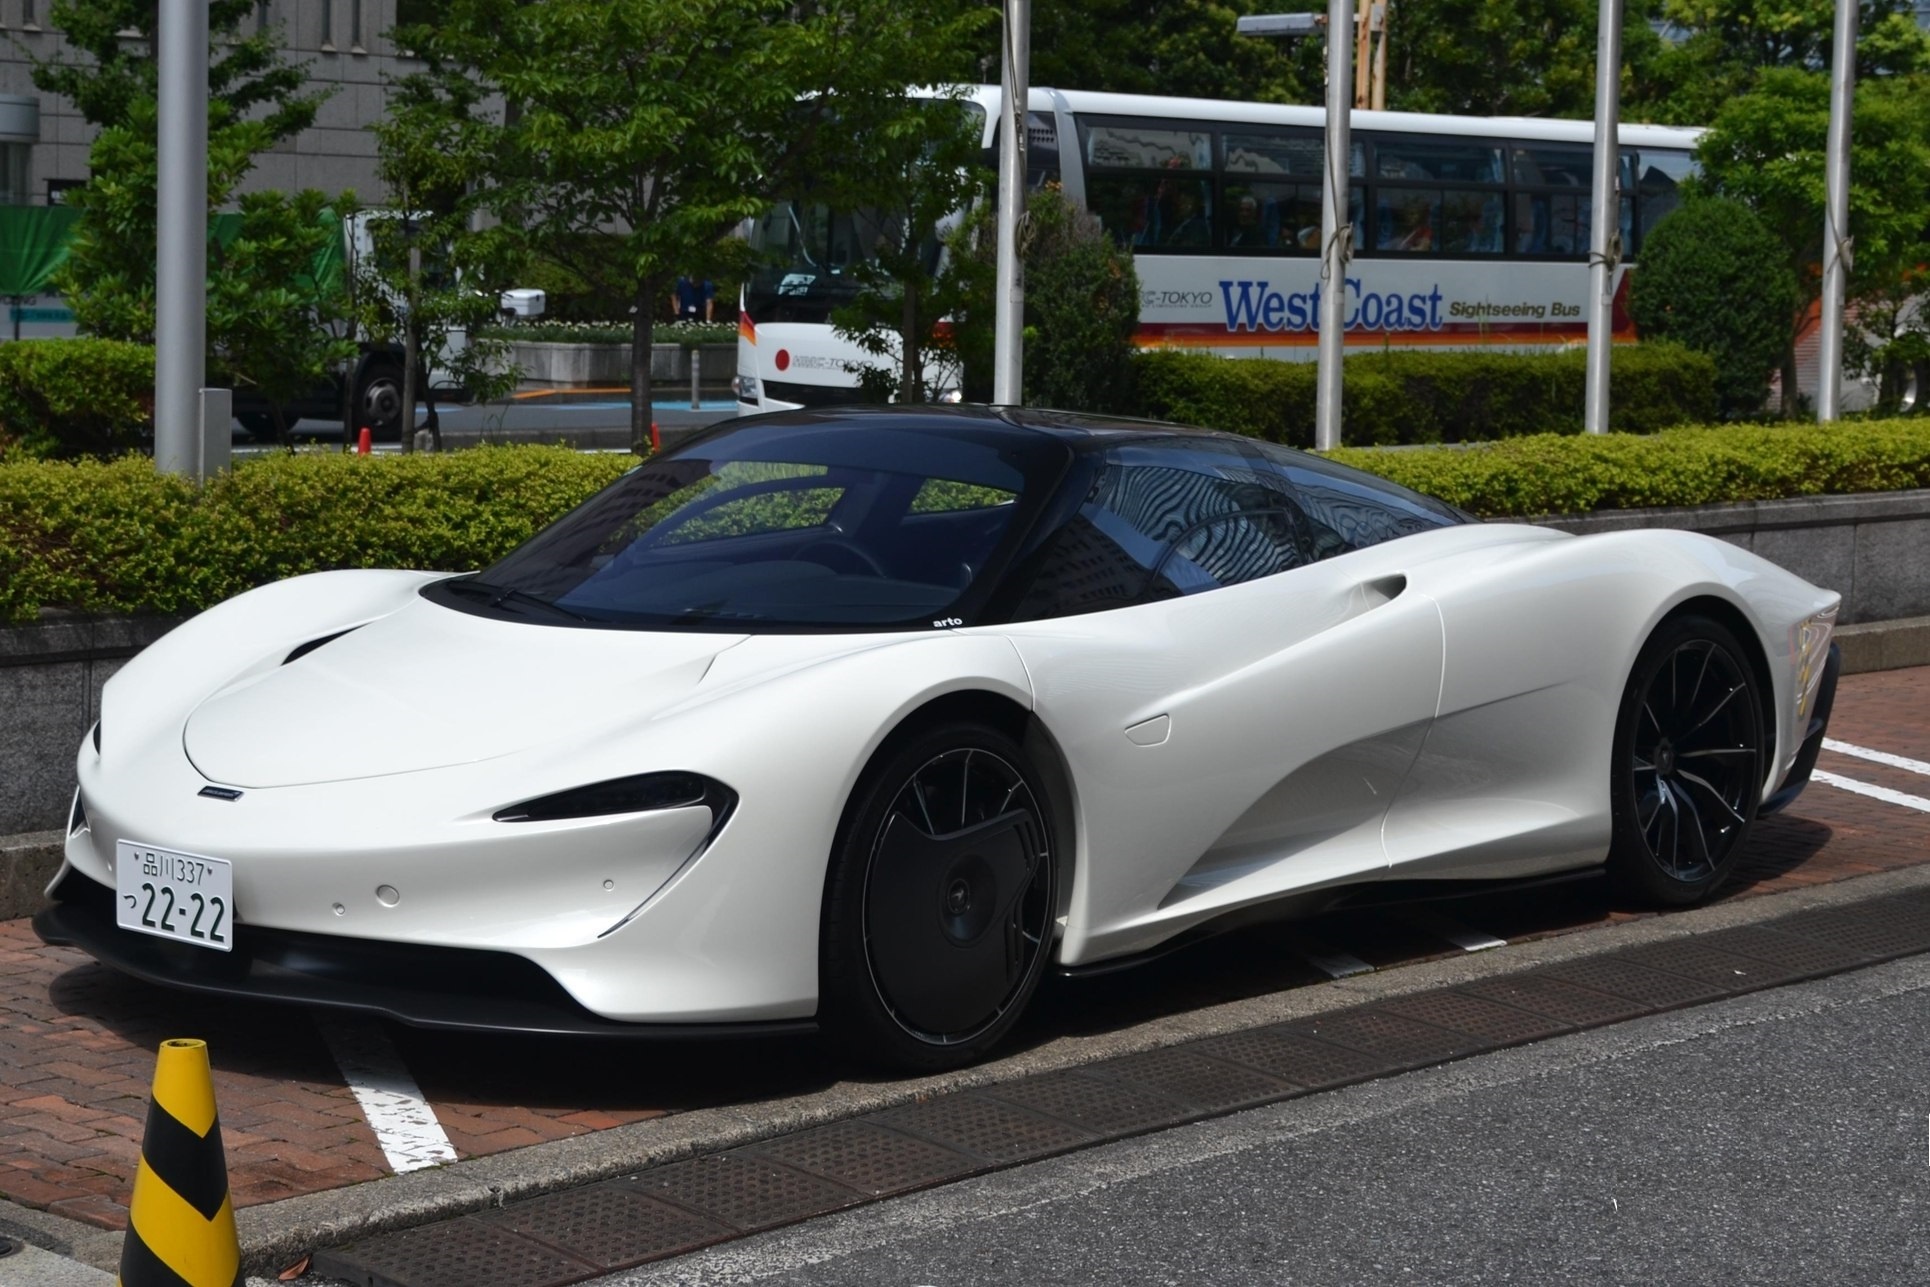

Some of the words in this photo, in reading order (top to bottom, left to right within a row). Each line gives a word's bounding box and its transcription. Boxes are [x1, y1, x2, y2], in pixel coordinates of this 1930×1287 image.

[1219, 281, 1319, 331] West
[1344, 279, 1443, 331] Coast
[1449, 301, 1546, 319] Sightseeing
[1551, 302, 1581, 317] Bus
[933, 617, 963, 628] arto
